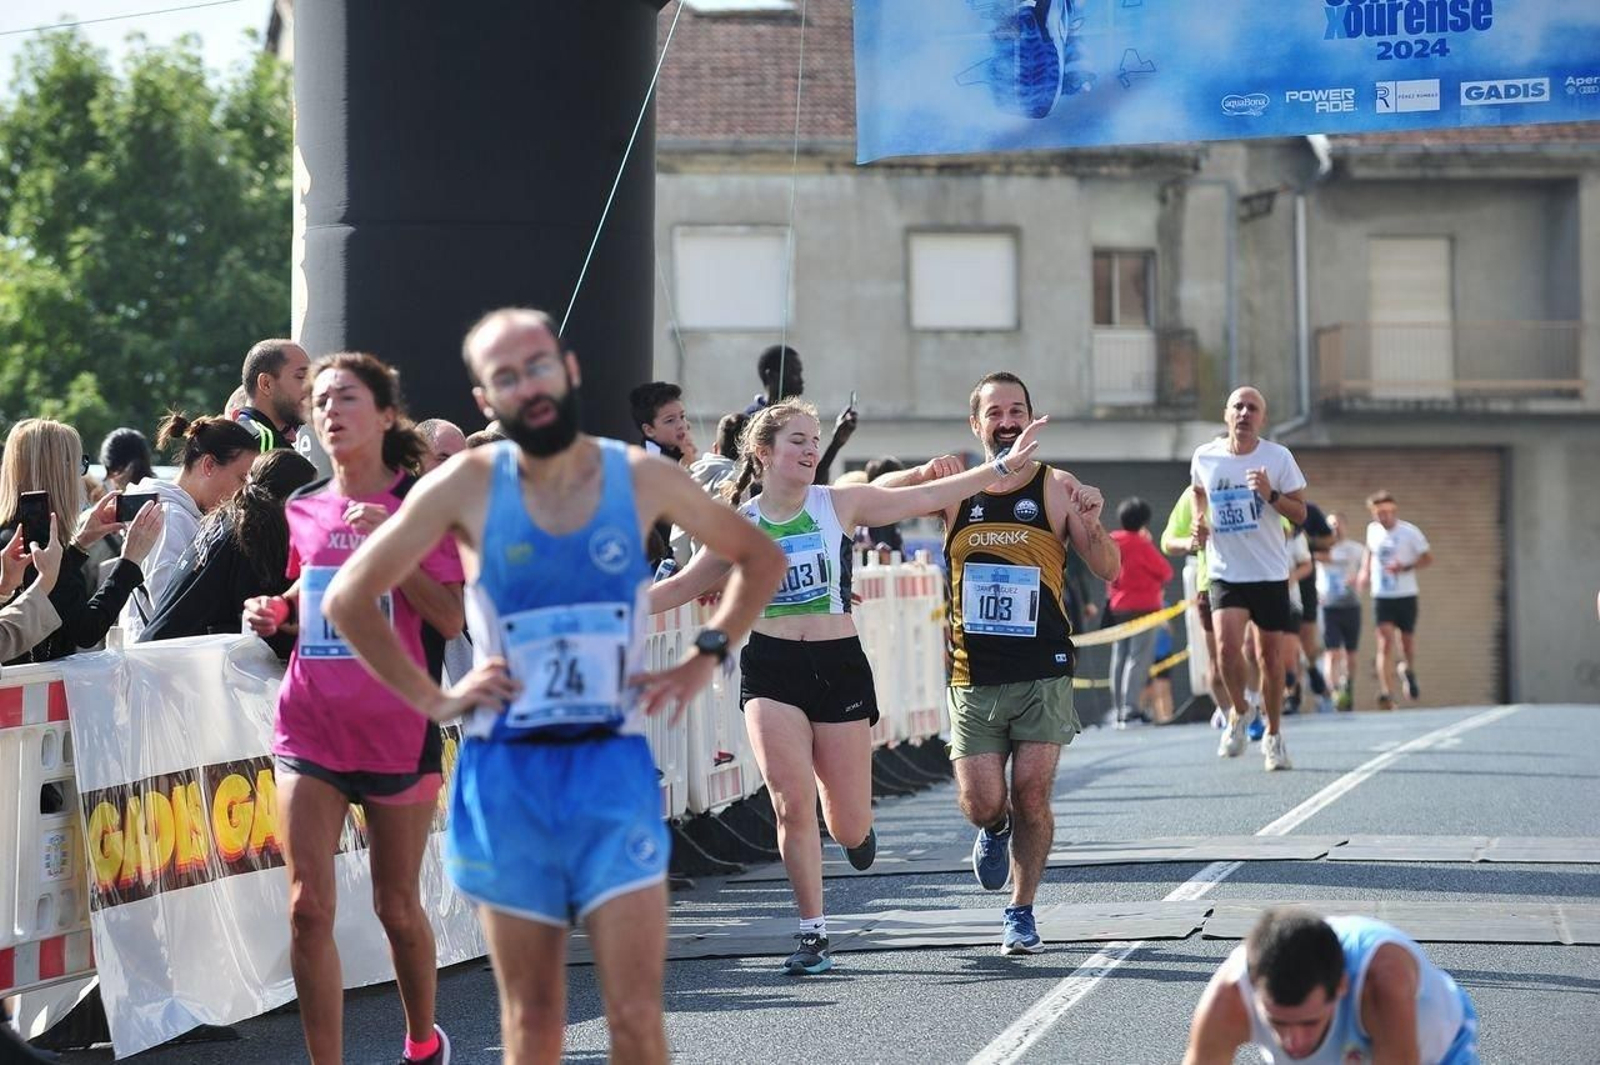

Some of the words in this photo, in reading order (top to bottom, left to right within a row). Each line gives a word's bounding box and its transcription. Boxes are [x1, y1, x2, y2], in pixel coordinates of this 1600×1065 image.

[1377, 38, 1450, 60] 2024
[1286, 88, 1355, 103] POWER
[1465, 82, 1545, 101] GADIS
[1219, 509, 1244, 526] 353
[969, 530, 1028, 547] OURENSE
[979, 595, 1012, 621] 103
[545, 657, 585, 699] 24
[213, 769, 283, 862] GA
